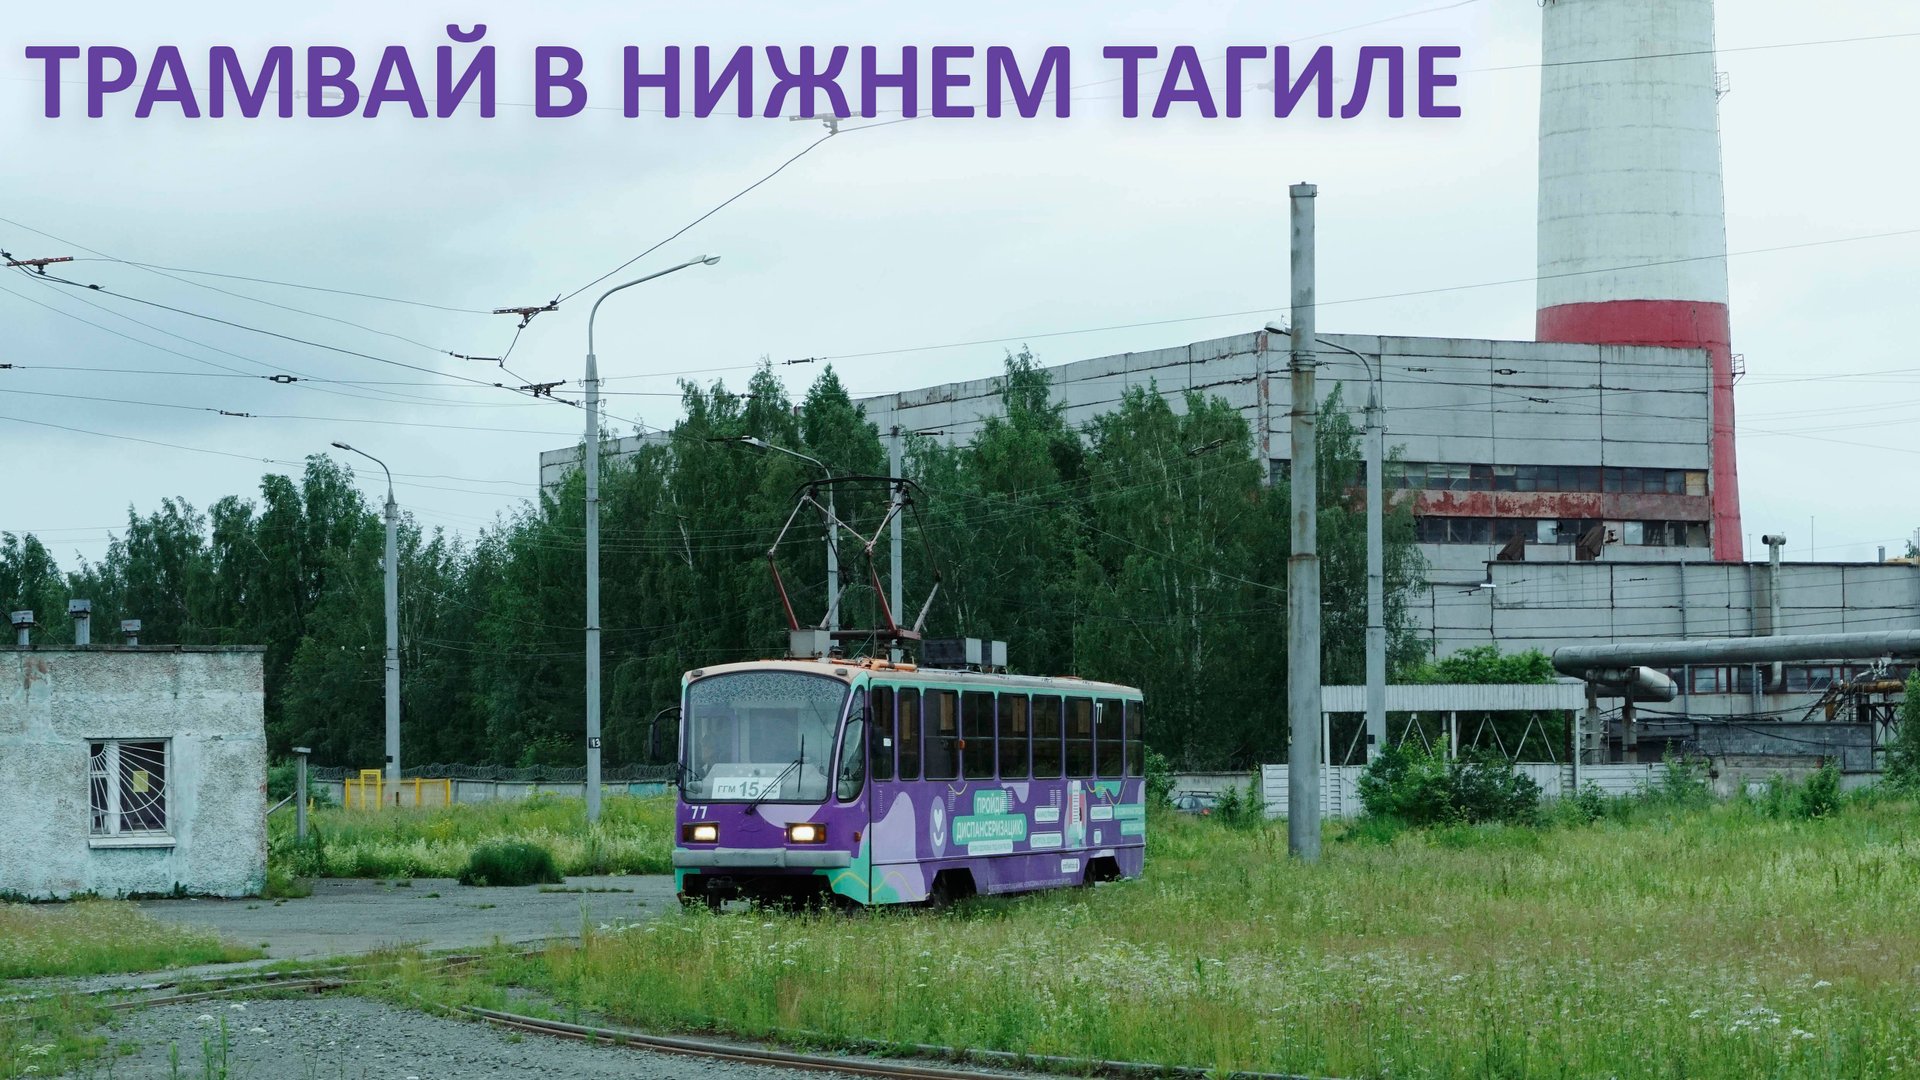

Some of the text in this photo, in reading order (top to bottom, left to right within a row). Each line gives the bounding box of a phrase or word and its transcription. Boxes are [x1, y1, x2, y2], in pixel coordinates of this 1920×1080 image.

[1095, 702, 1103, 724] 77
[717, 784, 736, 793] ГГМ
[739, 781, 759, 797] 15
[691, 805, 708, 819] 77
[956, 819, 1023, 842] ДИСПАНСЕРИЗАЦИЮ
